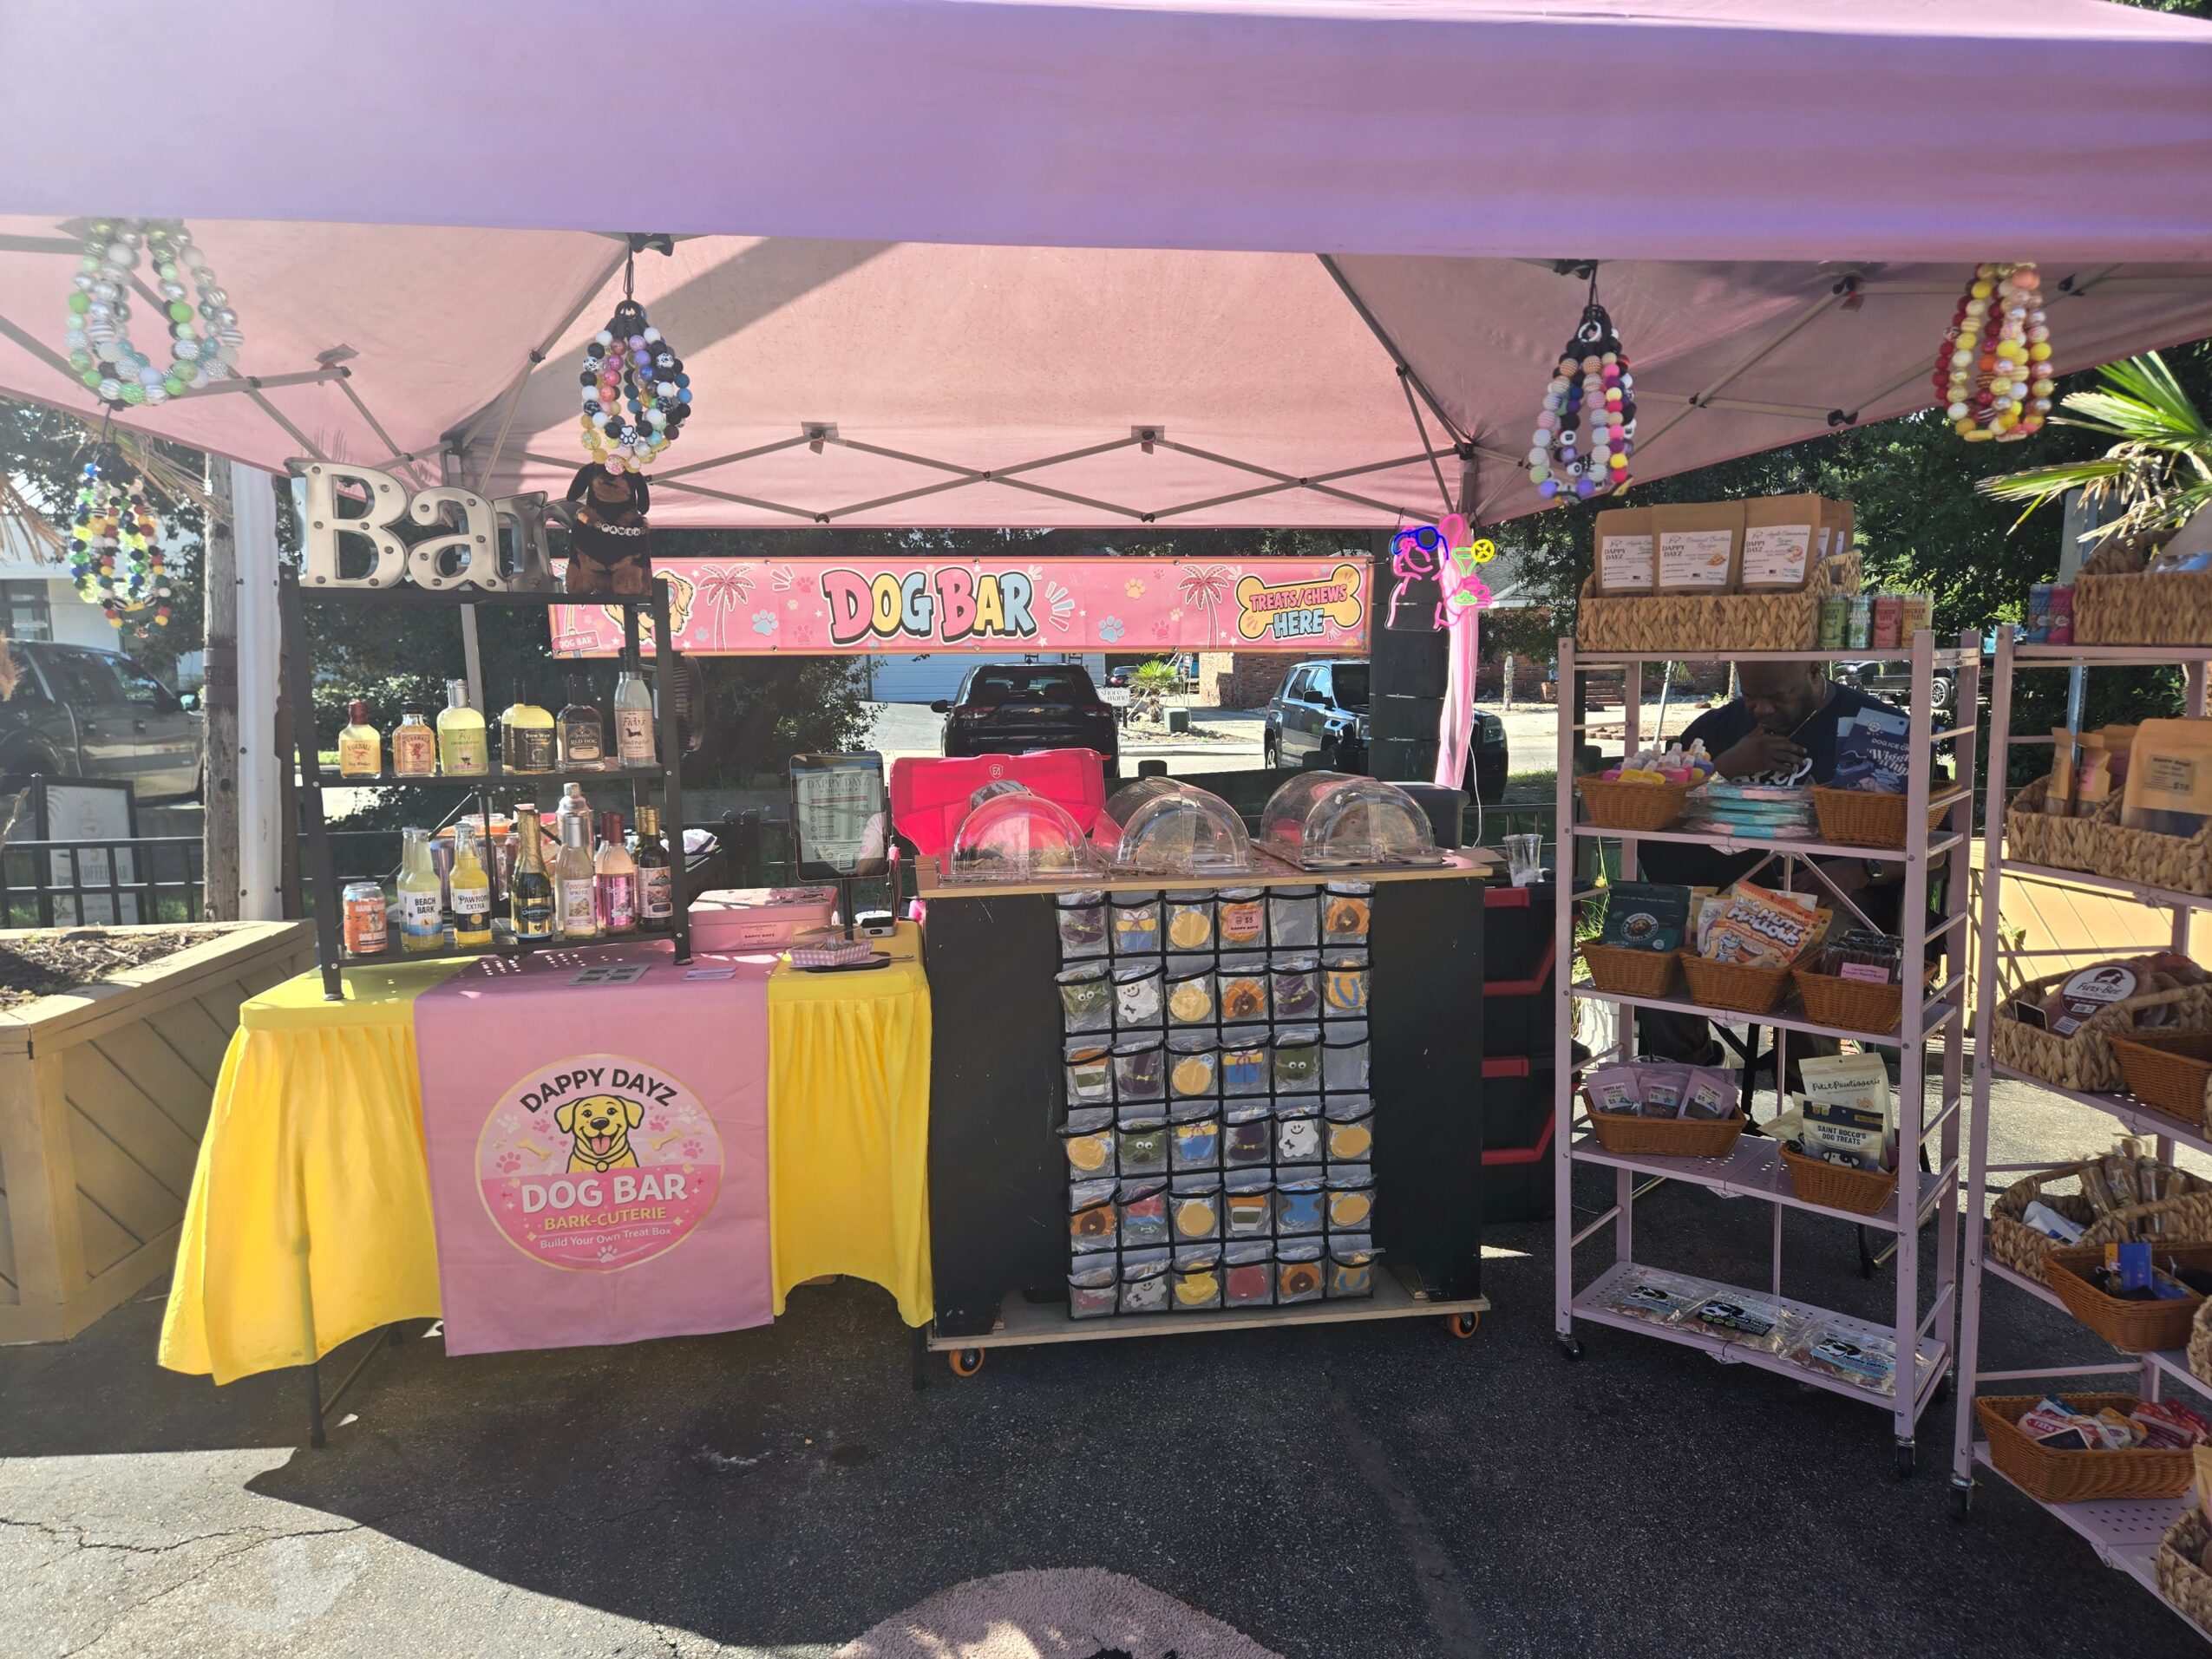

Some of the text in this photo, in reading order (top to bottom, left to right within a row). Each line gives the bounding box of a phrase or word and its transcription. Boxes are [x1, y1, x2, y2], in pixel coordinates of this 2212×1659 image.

[284, 461, 583, 592] Bar
[822, 566, 1037, 644] DOG BAR
[1249, 584, 1347, 612] TREATS/CHEWS
[1273, 608, 1325, 638] HERE
[559, 637, 592, 648] DOG BAR
[622, 716, 646, 727] Fido's
[807, 777, 870, 789] DAPPY DAYZ
[415, 898, 436, 906] BEACH
[1725, 906, 1801, 947] MALLOWS
[1757, 908, 1805, 935] MUTT
[519, 1068, 677, 1114] DAPPY DAYZ
[1812, 1078, 1881, 1091] Petit Pawtisserie
[1817, 1126, 1867, 1140] SAINT ROCCO'S
[1836, 1135, 1861, 1145] TREATS
[521, 1173, 688, 1213] DOG BAR
[544, 1206, 667, 1231] BARK-CUTERIE
[540, 1227, 671, 1250] Build Your Own Treat Box
